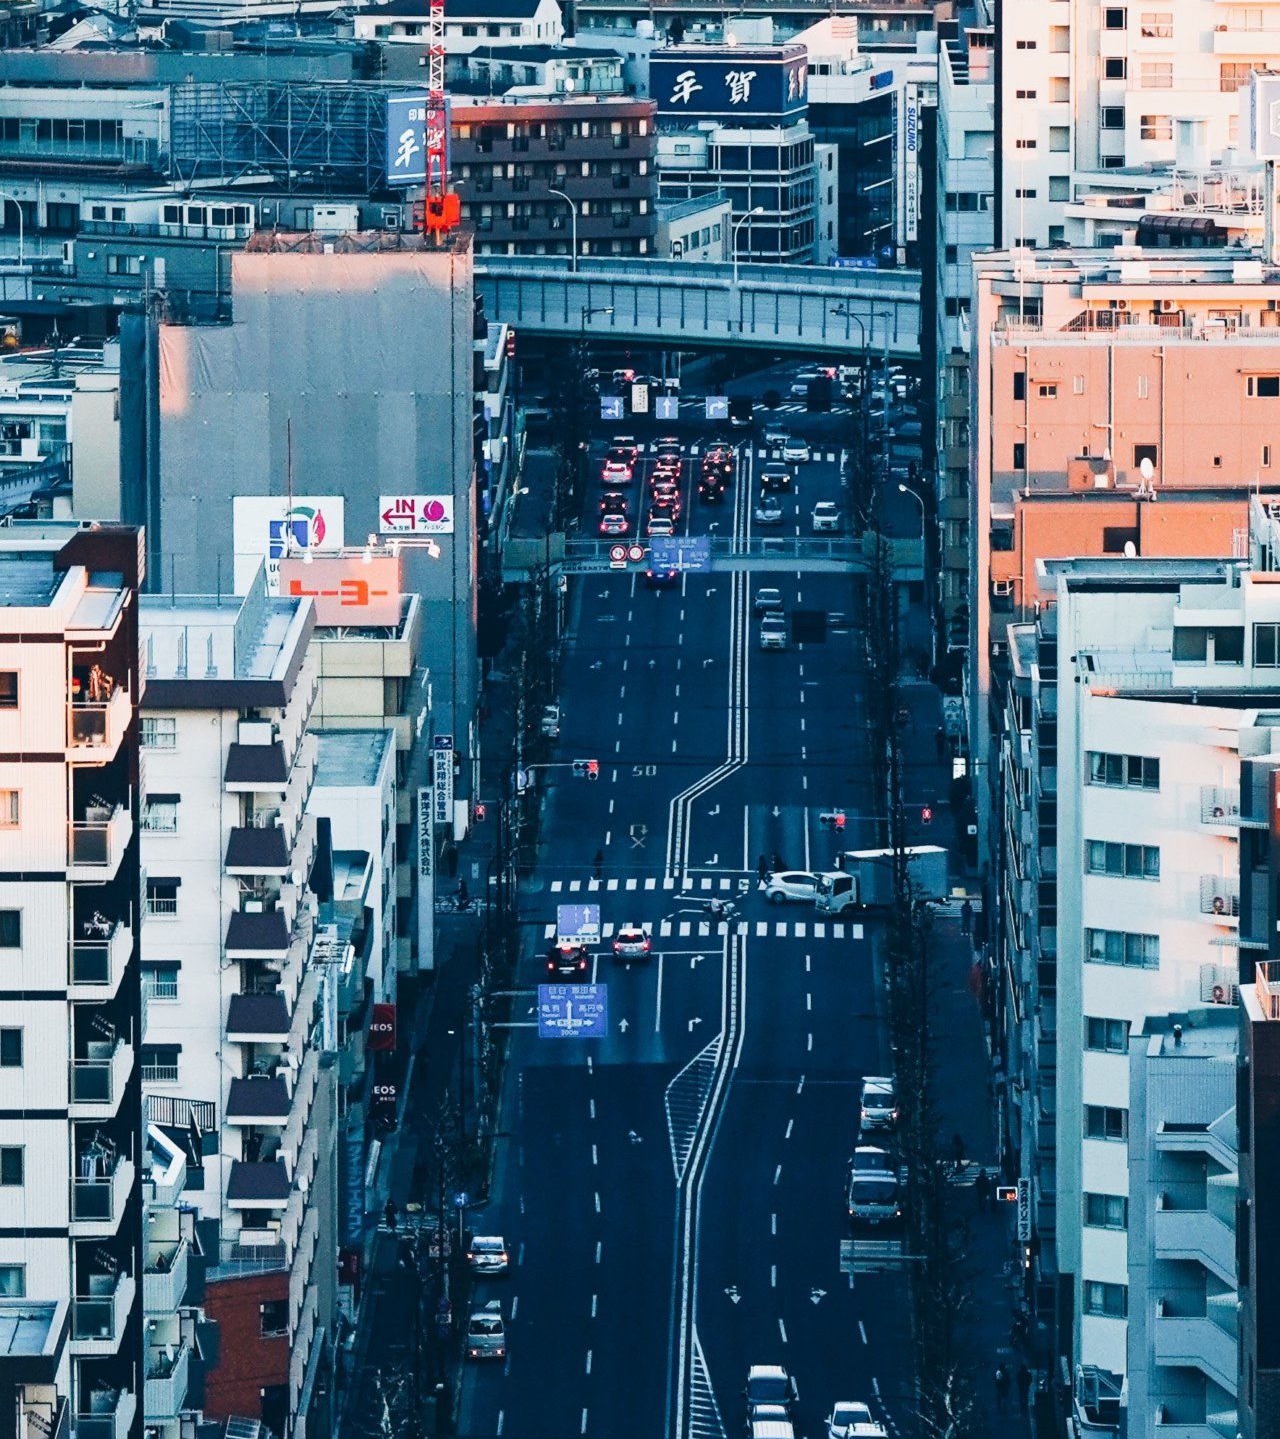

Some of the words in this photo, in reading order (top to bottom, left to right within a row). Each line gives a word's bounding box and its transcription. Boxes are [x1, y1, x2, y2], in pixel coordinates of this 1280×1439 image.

[670, 70, 757, 104] 平賀
[907, 107, 915, 152] SUZUMO
[396, 499, 415, 513] IN
[420, 791, 431, 877] 東洋ライス株式会社
